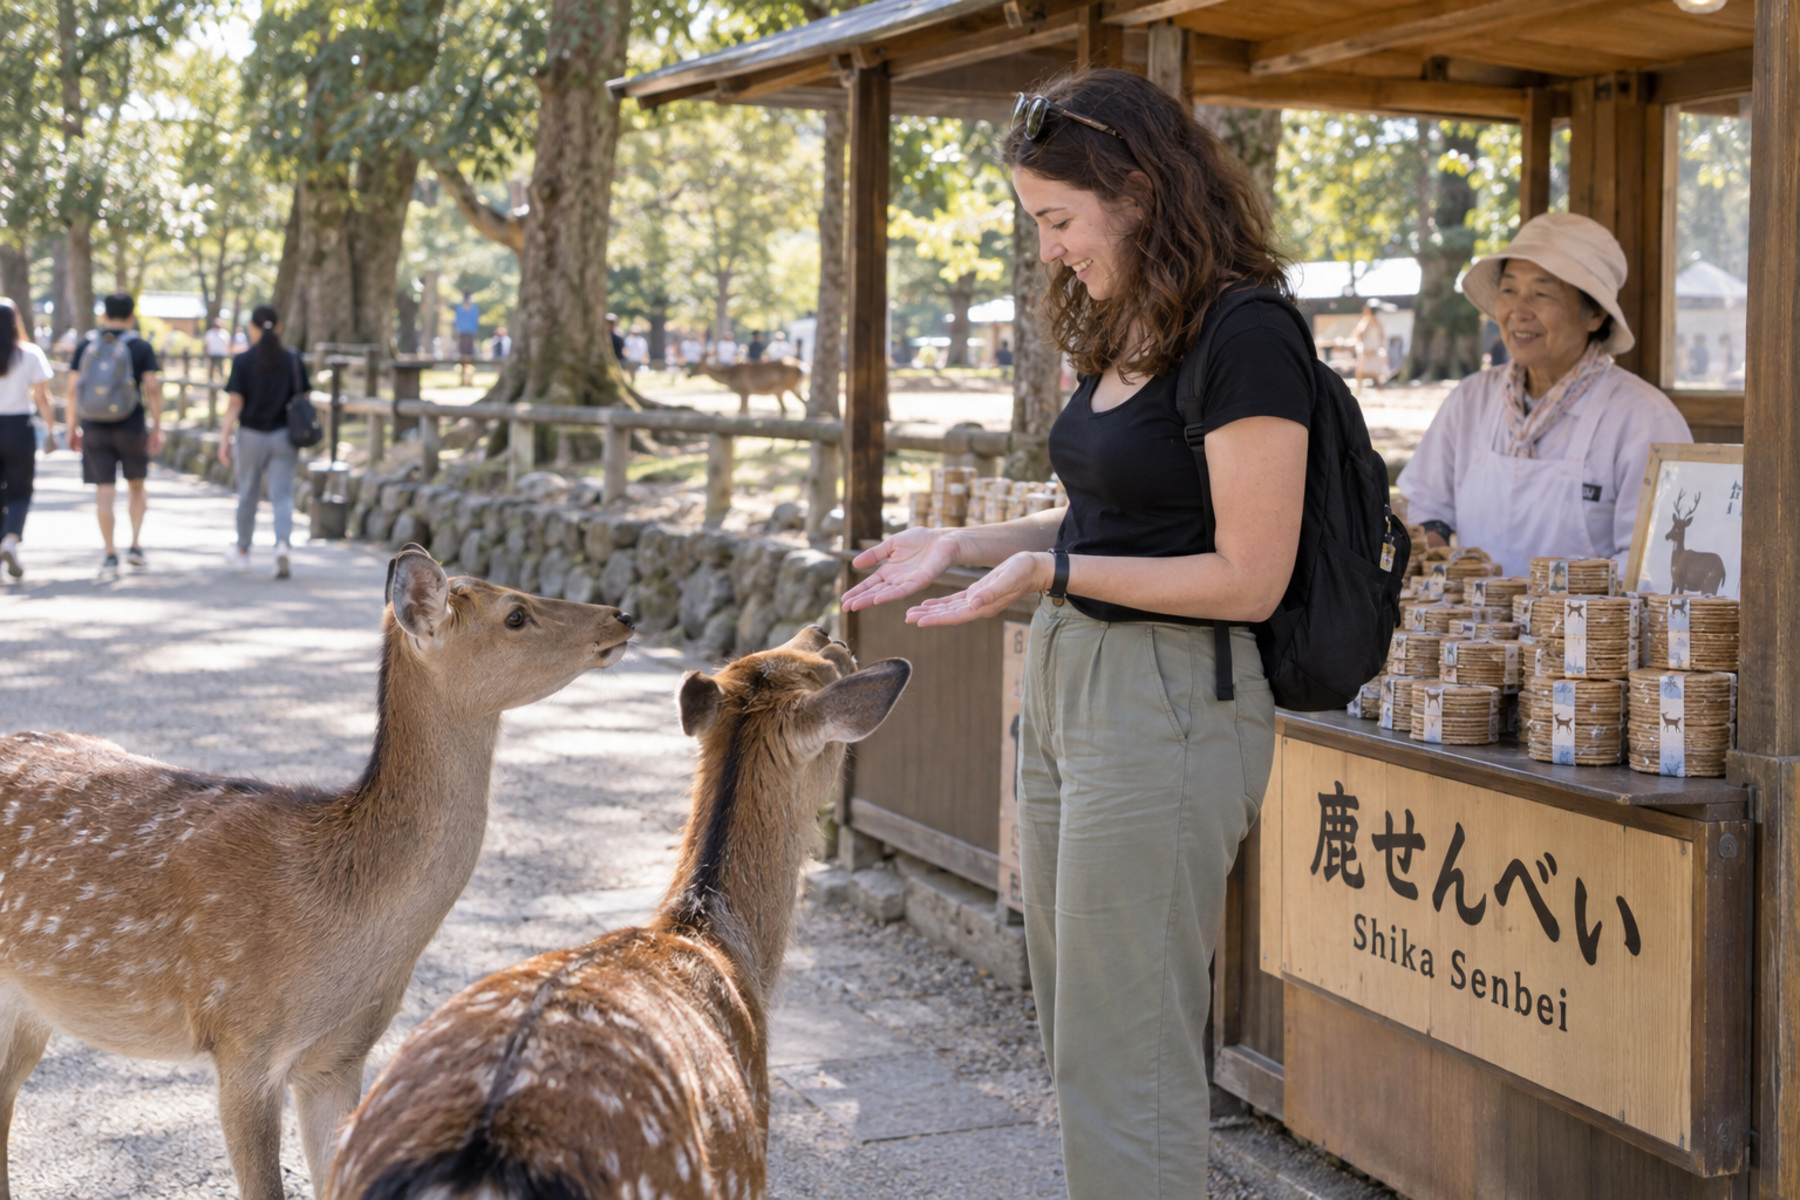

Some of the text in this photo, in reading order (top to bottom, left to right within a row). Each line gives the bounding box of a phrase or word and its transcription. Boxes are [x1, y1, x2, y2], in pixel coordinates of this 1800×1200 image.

[1310, 780, 1642, 966] 鹿せんべい
[1353, 913, 1568, 1033] Shika Senbei
